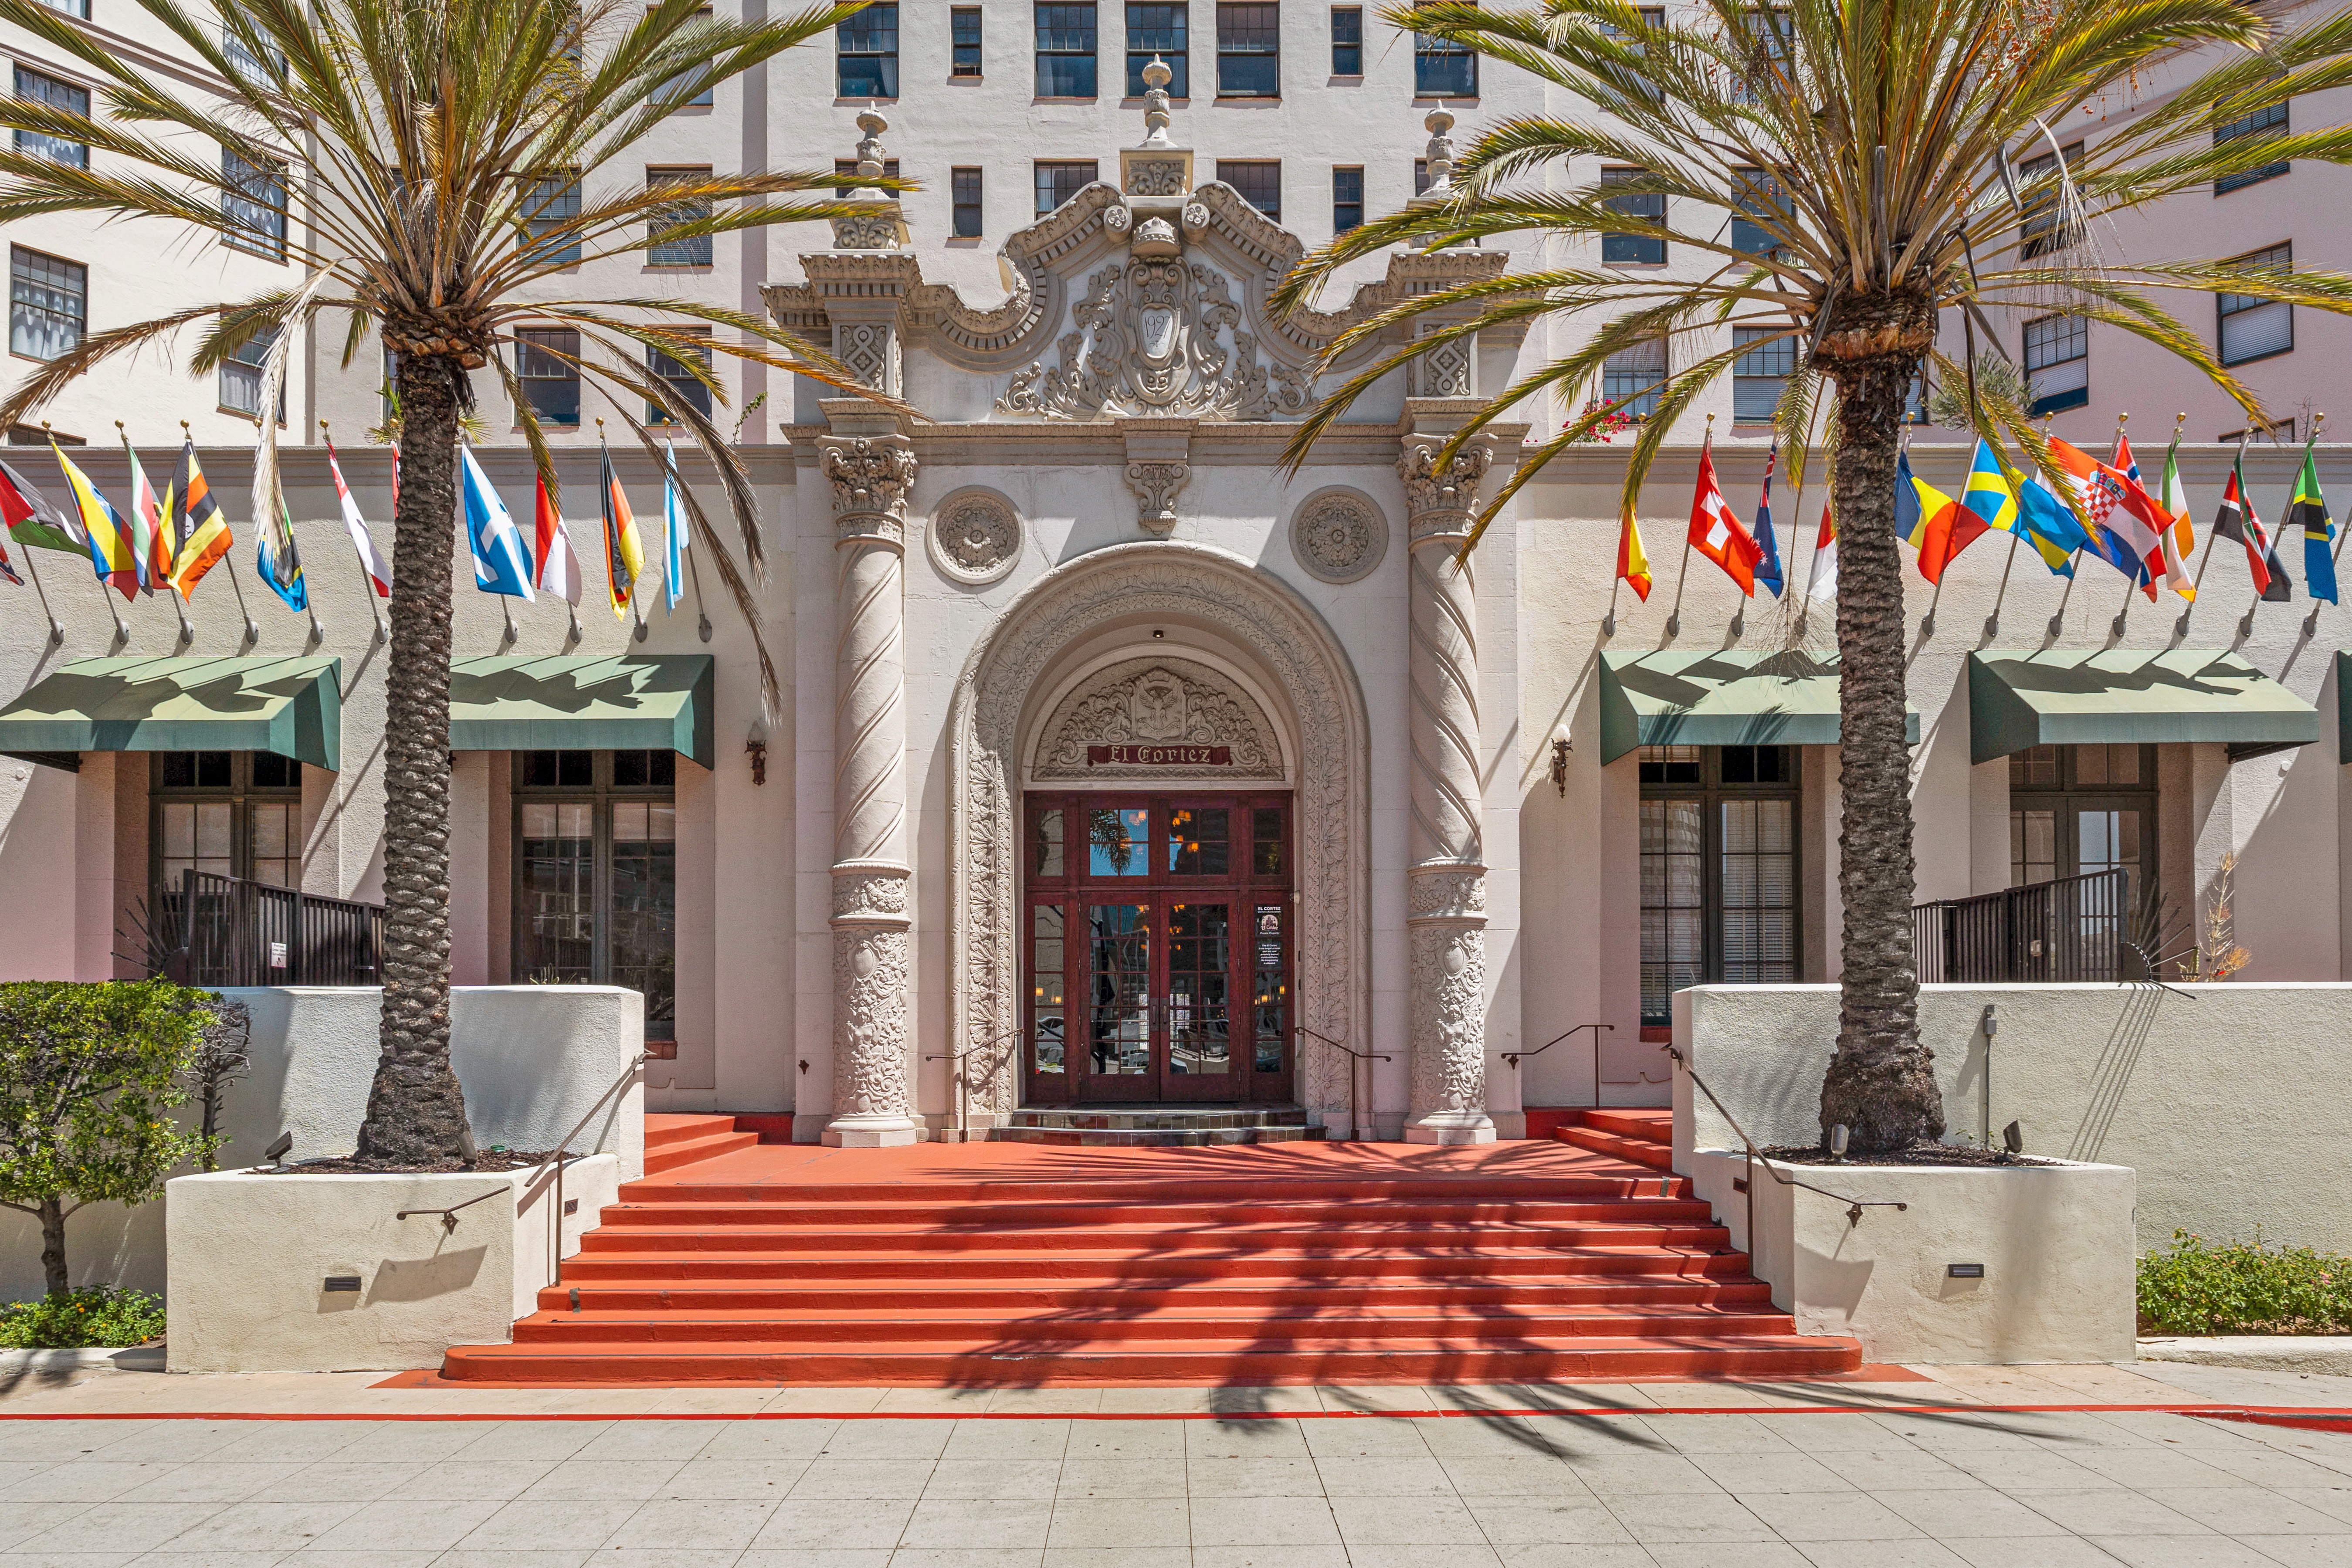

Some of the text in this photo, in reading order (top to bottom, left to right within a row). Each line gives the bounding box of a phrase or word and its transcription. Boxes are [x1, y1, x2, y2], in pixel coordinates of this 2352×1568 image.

[1143, 315, 1171, 339] 1927
[1111, 745, 1210, 763] El Cortez
